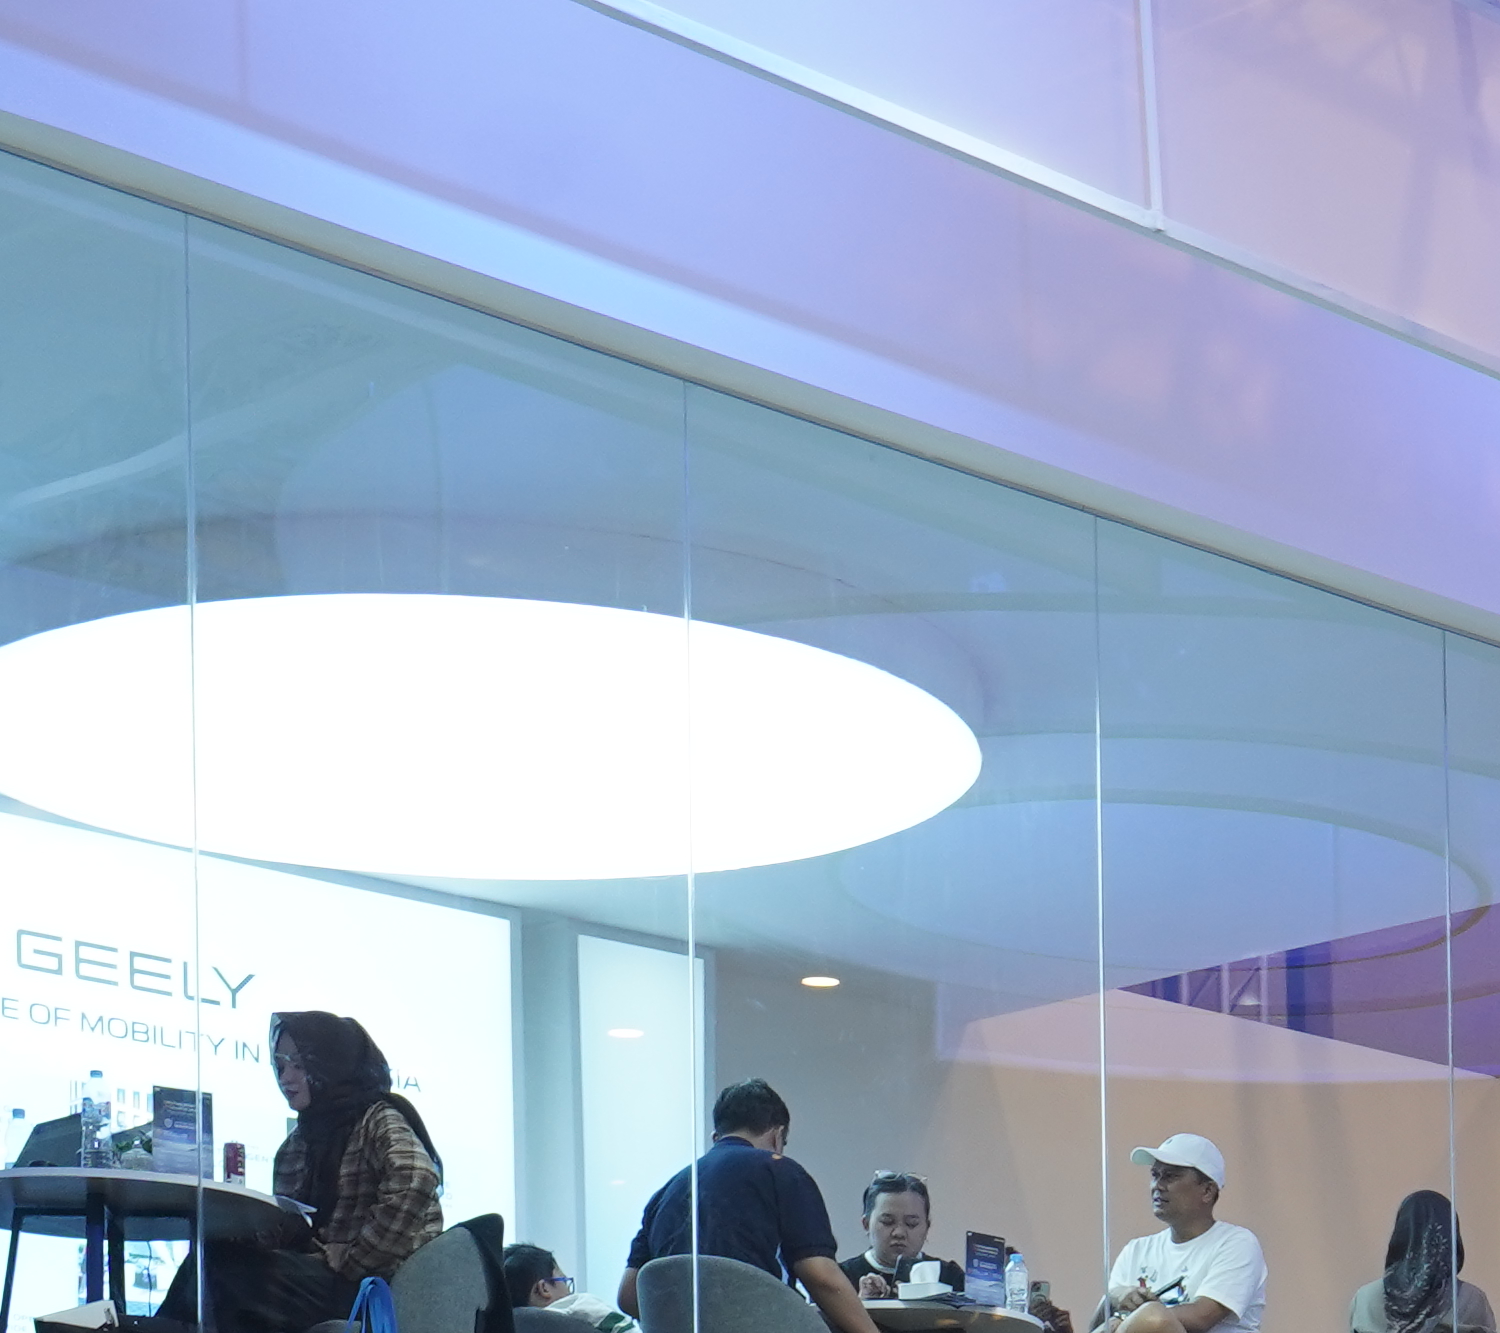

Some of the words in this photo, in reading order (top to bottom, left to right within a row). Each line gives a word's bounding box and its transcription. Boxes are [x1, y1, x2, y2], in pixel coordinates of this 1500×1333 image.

[16, 928, 256, 1010] GEELY
[28, 1003, 72, 1031] OF
[79, 1014, 225, 1057] MOBILITY
[234, 1038, 261, 1065] IN
